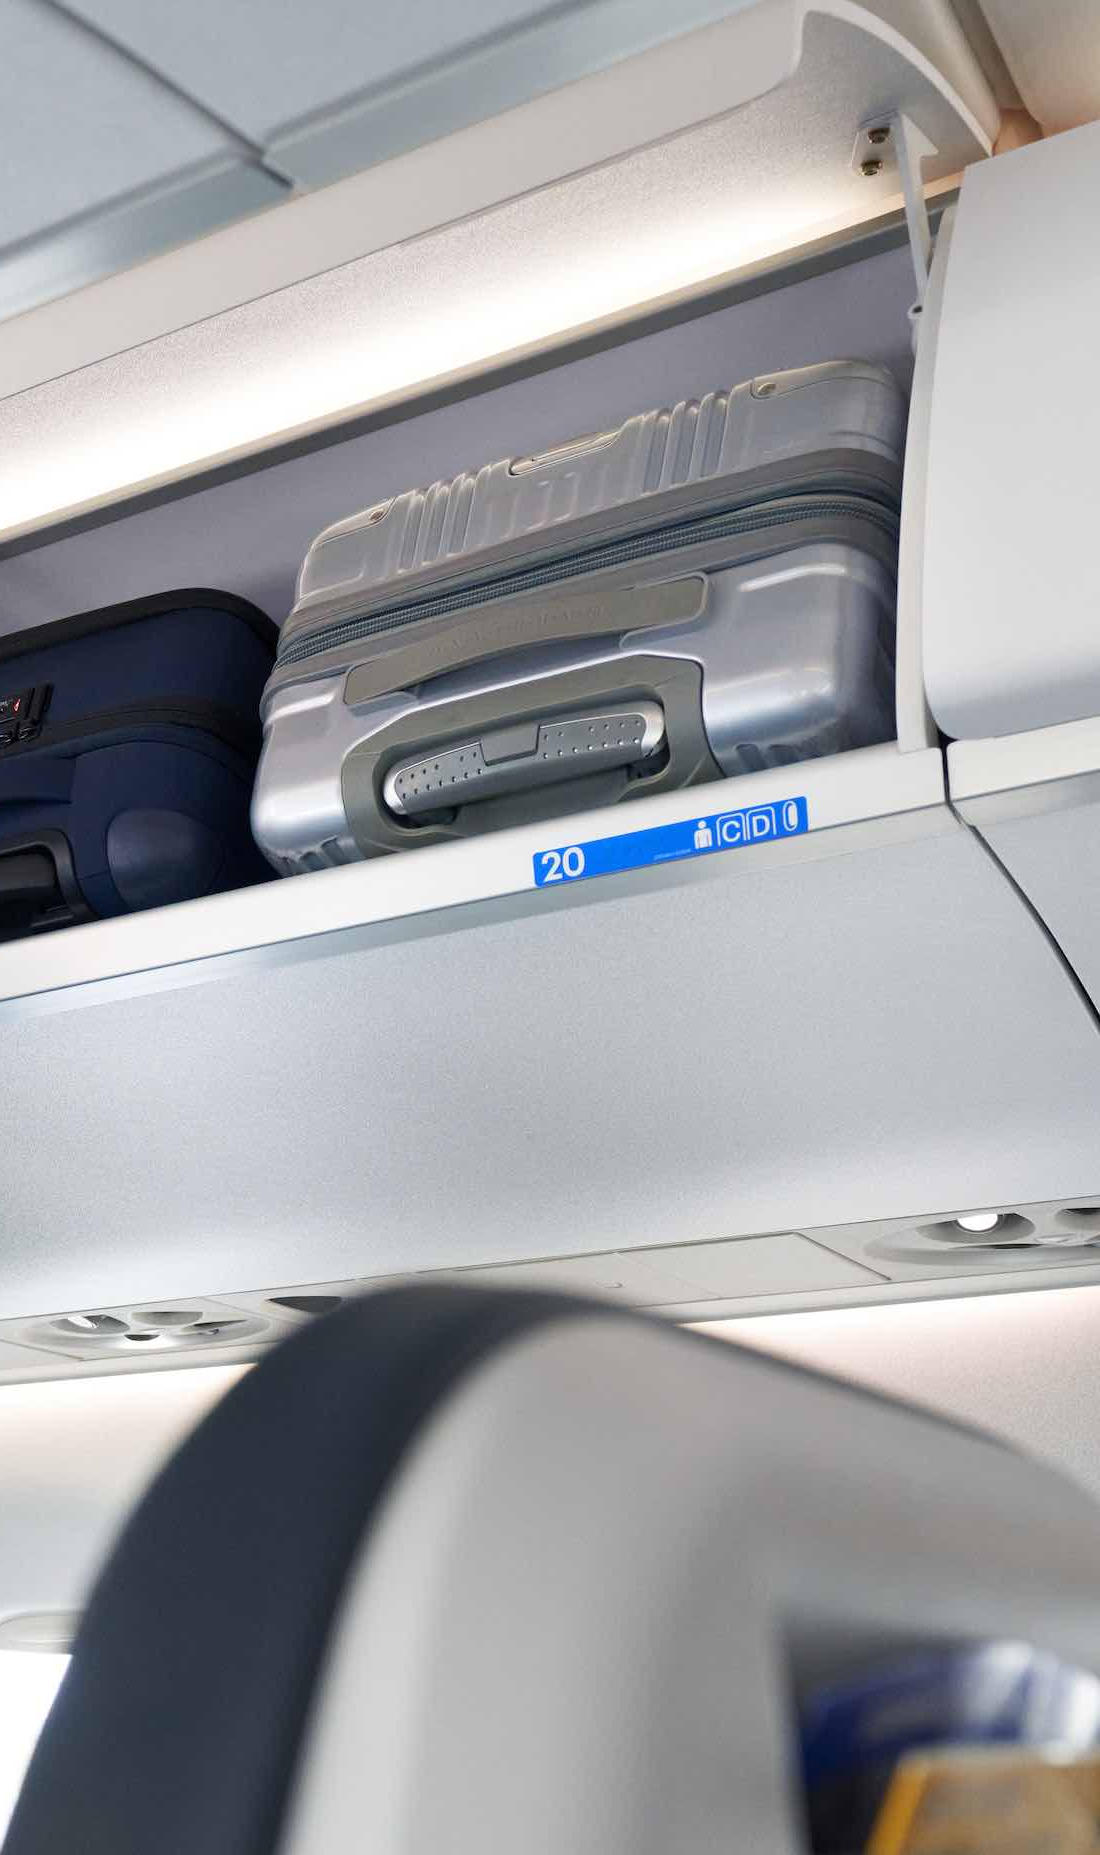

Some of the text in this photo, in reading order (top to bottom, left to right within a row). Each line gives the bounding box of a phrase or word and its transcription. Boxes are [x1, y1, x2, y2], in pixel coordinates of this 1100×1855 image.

[541, 814, 771, 882] 20 C D
